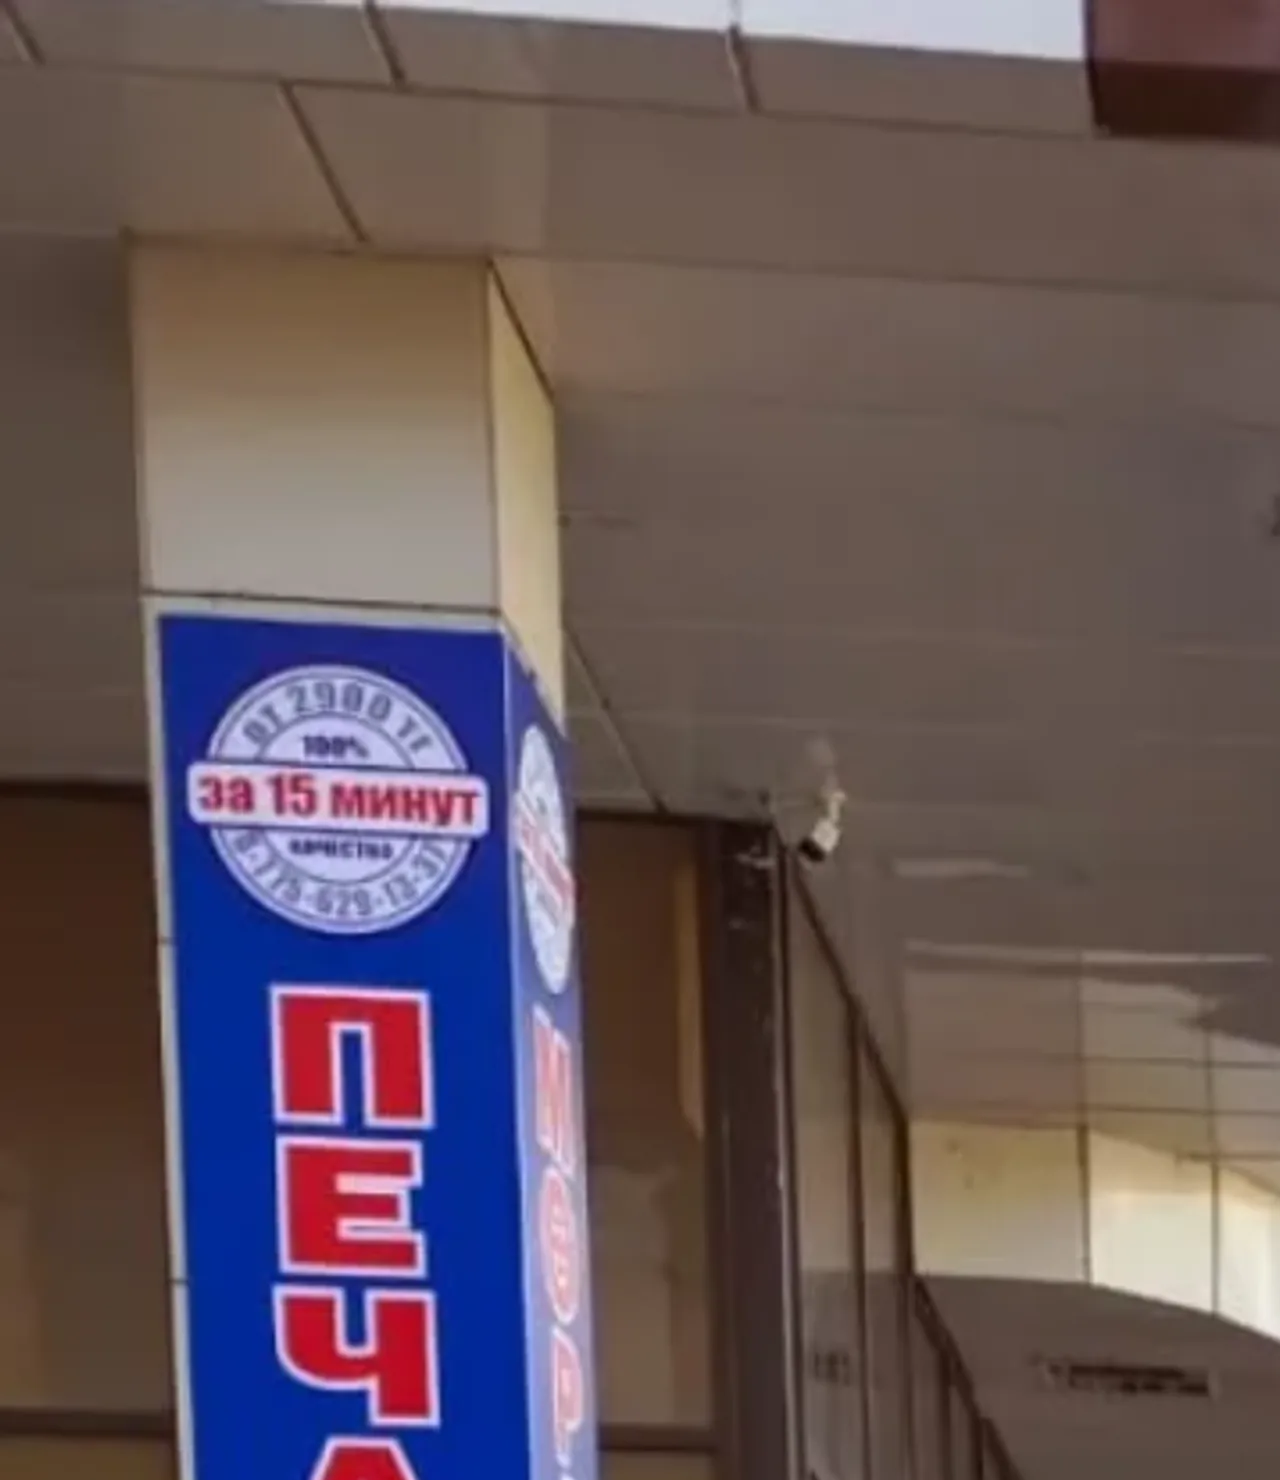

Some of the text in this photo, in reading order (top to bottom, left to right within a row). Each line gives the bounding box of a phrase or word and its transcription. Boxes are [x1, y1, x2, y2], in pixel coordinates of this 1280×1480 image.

[198, 773, 481, 827] за 15 минут
